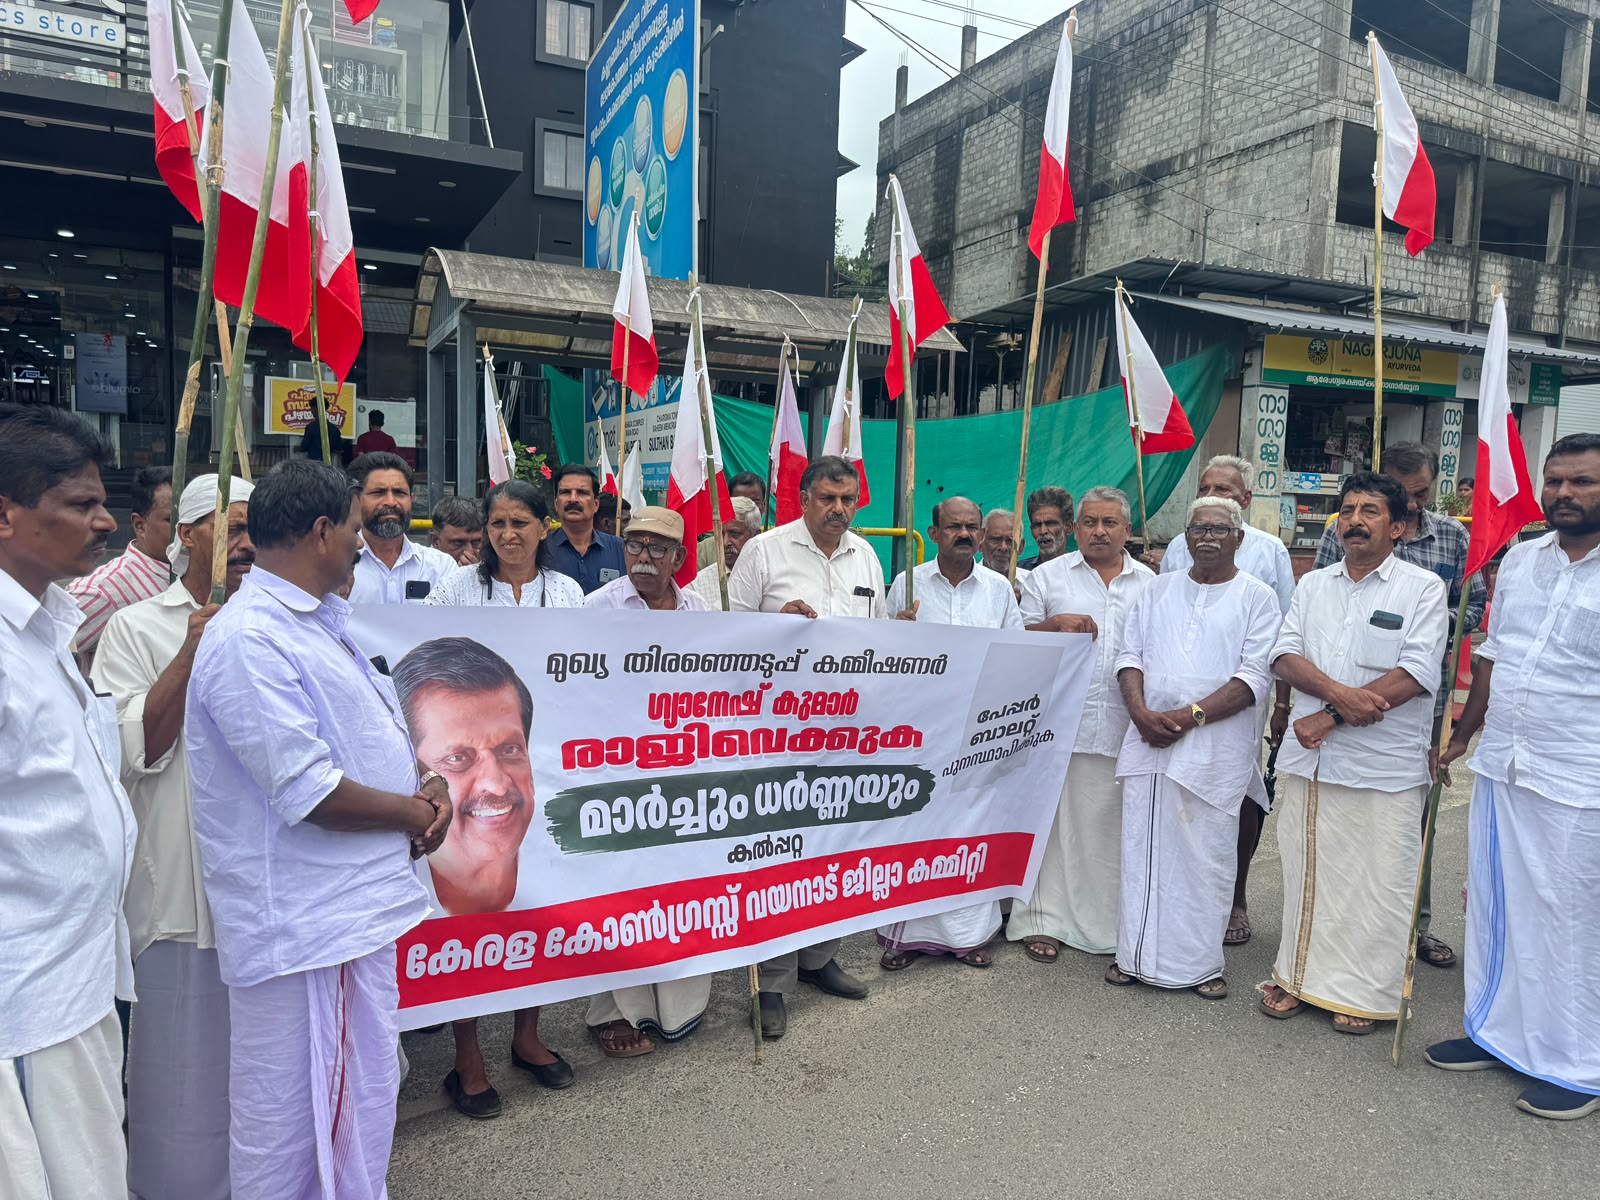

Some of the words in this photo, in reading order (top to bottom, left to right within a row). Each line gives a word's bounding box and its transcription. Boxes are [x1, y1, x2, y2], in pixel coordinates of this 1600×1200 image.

[39, 15, 116, 42] store
[1387, 362, 1421, 372] AYURVEDA
[649, 436, 669, 452] SULTHAN
[546, 651, 609, 683] മുഖ്യ
[623, 644, 809, 679] തിരഞ്ഞെടുപ്പ്
[811, 648, 948, 675] കമ്മീഷണർ
[647, 682, 773, 728] ഗ്യാനേഷ്
[772, 687, 860, 722] കുമാർ
[977, 693, 1040, 724] പേപ്പർ
[560, 721, 923, 771] രാജിവെക്കുക
[970, 712, 1040, 747] ബാലറ്റ്
[942, 729, 1054, 777] പുനസ്ഥാപിക്കുക
[579, 783, 748, 838] മാർച്ചും
[754, 771, 920, 820] ധർണ്ണയും
[727, 833, 804, 864] കൽപ്പറ്റ
[406, 930, 538, 980] കേരള
[543, 883, 742, 958] കോൺഗ്രസ്സ്
[746, 862, 840, 922] വയനാട്
[842, 856, 903, 902] ജില്ലാ
[907, 841, 988, 885] കമ്മിറ്റി
